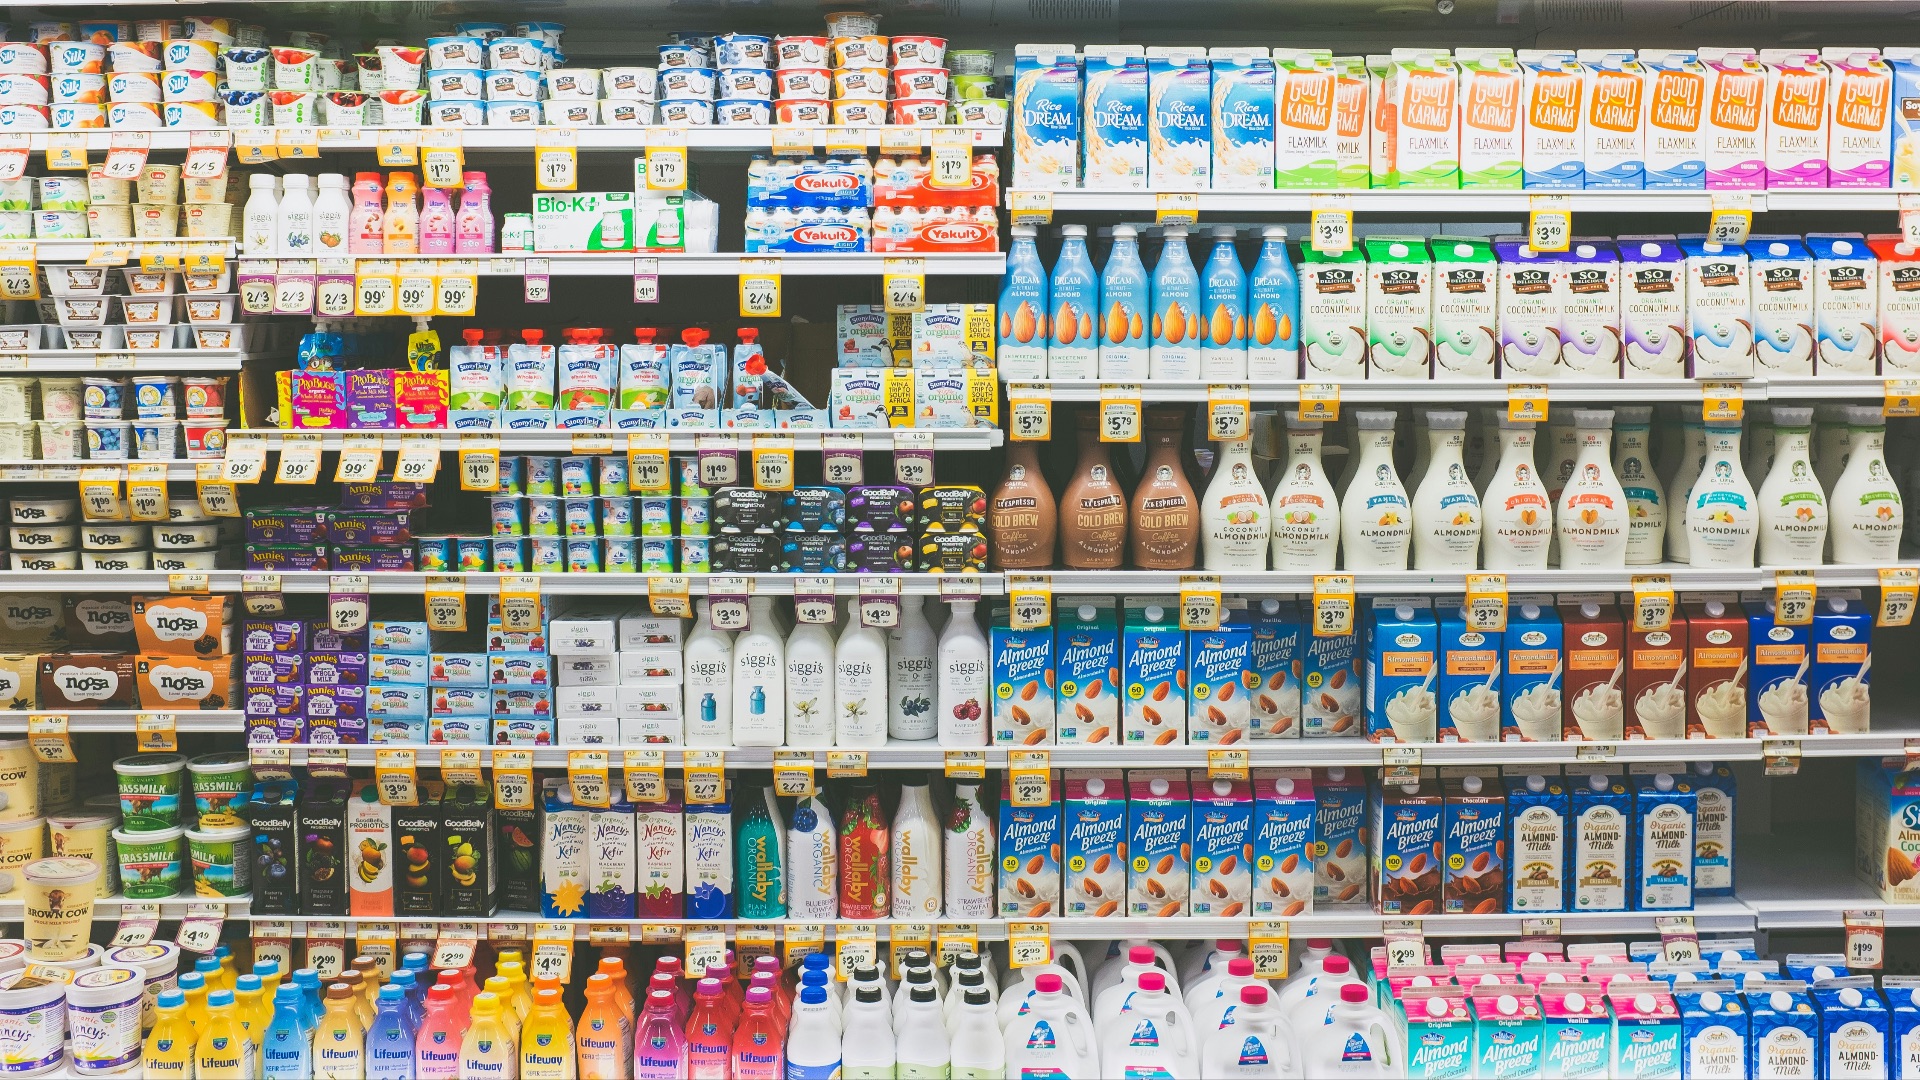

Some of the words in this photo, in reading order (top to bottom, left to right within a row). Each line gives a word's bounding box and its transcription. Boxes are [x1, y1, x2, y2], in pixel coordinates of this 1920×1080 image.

[62, 48, 84, 64] Silk
[170, 45, 189, 62] Silk
[60, 79, 80, 94] Silk
[1289, 75, 1329, 107] GOOD
[1410, 74, 1452, 106] GOOD
[1538, 75, 1579, 106] GOOD
[1660, 75, 1698, 106] GOOD
[1782, 74, 1820, 106] GOOD
[1036, 99, 1062, 112] Rice
[1170, 100, 1194, 112] Rice
[1234, 100, 1260, 112] Rice
[166, 107, 182, 123] Silk
[1024, 112, 1070, 126] DREAM
[1158, 112, 1202, 127] DREAM
[1222, 112, 1266, 127] DREAM
[1286, 104, 1327, 128] KARMA
[1408, 104, 1449, 128] KARMA
[1536, 105, 1576, 128] KARMA
[1657, 104, 1696, 128] KARMA
[1780, 103, 1818, 126] KARMA
[1288, 136, 1328, 148] FLAXMILK
[1410, 138, 1448, 150] FLAXMILK
[1538, 138, 1576, 150] FLAXMILK
[1658, 138, 1696, 150] FLAXMILK
[1780, 136, 1818, 148] FLAXMILK
[804, 176, 850, 190] Yakult
[804, 228, 848, 242] Yakult
[1326, 271, 1344, 280] SO
[1390, 272, 1408, 281] SO
[1523, 272, 1541, 281] SO
[1644, 270, 1663, 280] SO
[1774, 269, 1792, 279] SO
[364, 290, 386, 304] 99¢
[402, 290, 424, 304] 99¢
[1310, 305, 1361, 314] COCONUTMILK
[1374, 306, 1426, 315] COCONUTMILK
[1507, 306, 1557, 315] COCONUTMILK
[1629, 304, 1680, 314] COCONUTMILK
[1758, 303, 1808, 312] COCONUTMILK
[458, 361, 491, 372] Stonyfield
[846, 381, 880, 390] Stonyfield
[846, 393, 880, 404] organic
[928, 393, 963, 404] organic
[456, 418, 492, 430] Stonyfield
[230, 464, 253, 475] 99¢
[344, 463, 366, 474] 99¢
[730, 490, 767, 499] GoodBelly
[862, 489, 899, 499] GoodBelly
[14, 506, 46, 519] noosa
[252, 518, 284, 529] Annie's
[334, 519, 366, 530] Annie's
[992, 514, 1010, 528] COLD
[1013, 514, 1038, 528] BREW
[1140, 514, 1162, 528] COLD
[1163, 514, 1189, 528] BREW
[1562, 527, 1620, 536] ALMONDMILK
[1692, 526, 1750, 536] ALMONDMILK
[90, 532, 122, 545] noosa
[162, 532, 195, 545] noosa
[157, 616, 199, 632] noosa
[246, 622, 274, 632] Annie's
[998, 640, 1049, 667] Almond
[1130, 640, 1181, 667] Almond
[690, 660, 727, 675] siggi's
[789, 661, 824, 675] siggi's
[898, 658, 933, 672] siggi's
[1008, 657, 1045, 677] Breeze
[1140, 657, 1176, 677] Breeze
[66, 676, 110, 691] noosa
[252, 818, 291, 830] GoodBelly
[1070, 815, 1122, 842] Almond
[1387, 814, 1438, 840] Almond
[1520, 824, 1557, 834] Organic
[554, 823, 586, 841] Nancy's
[694, 824, 726, 842] Nancy's
[1082, 832, 1117, 852] Breeze
[1398, 830, 1434, 851] Breeze
[1526, 842, 1552, 851] Milk
[559, 846, 580, 859] Kefir
[697, 848, 720, 860] Kefir
[748, 837, 759, 891] ORGANIC
[754, 835, 768, 902] wallaby
[844, 836, 853, 890] ORGANIC
[850, 836, 868, 902] wallaby
[28, 907, 64, 919] BROWN
[66, 906, 89, 918] COW
[690, 1042, 728, 1054] Lifeway
[1482, 1036, 1538, 1063] Almond
[1838, 1040, 1877, 1051] Organic
[266, 1048, 300, 1060] Lifeway
[374, 1048, 412, 1060] Lifeway
[526, 1052, 563, 1066] Lifeway
[146, 1058, 184, 1071] Lifeway
[1494, 1054, 1533, 1076] Breeze
[1844, 1060, 1872, 1071] Milk
